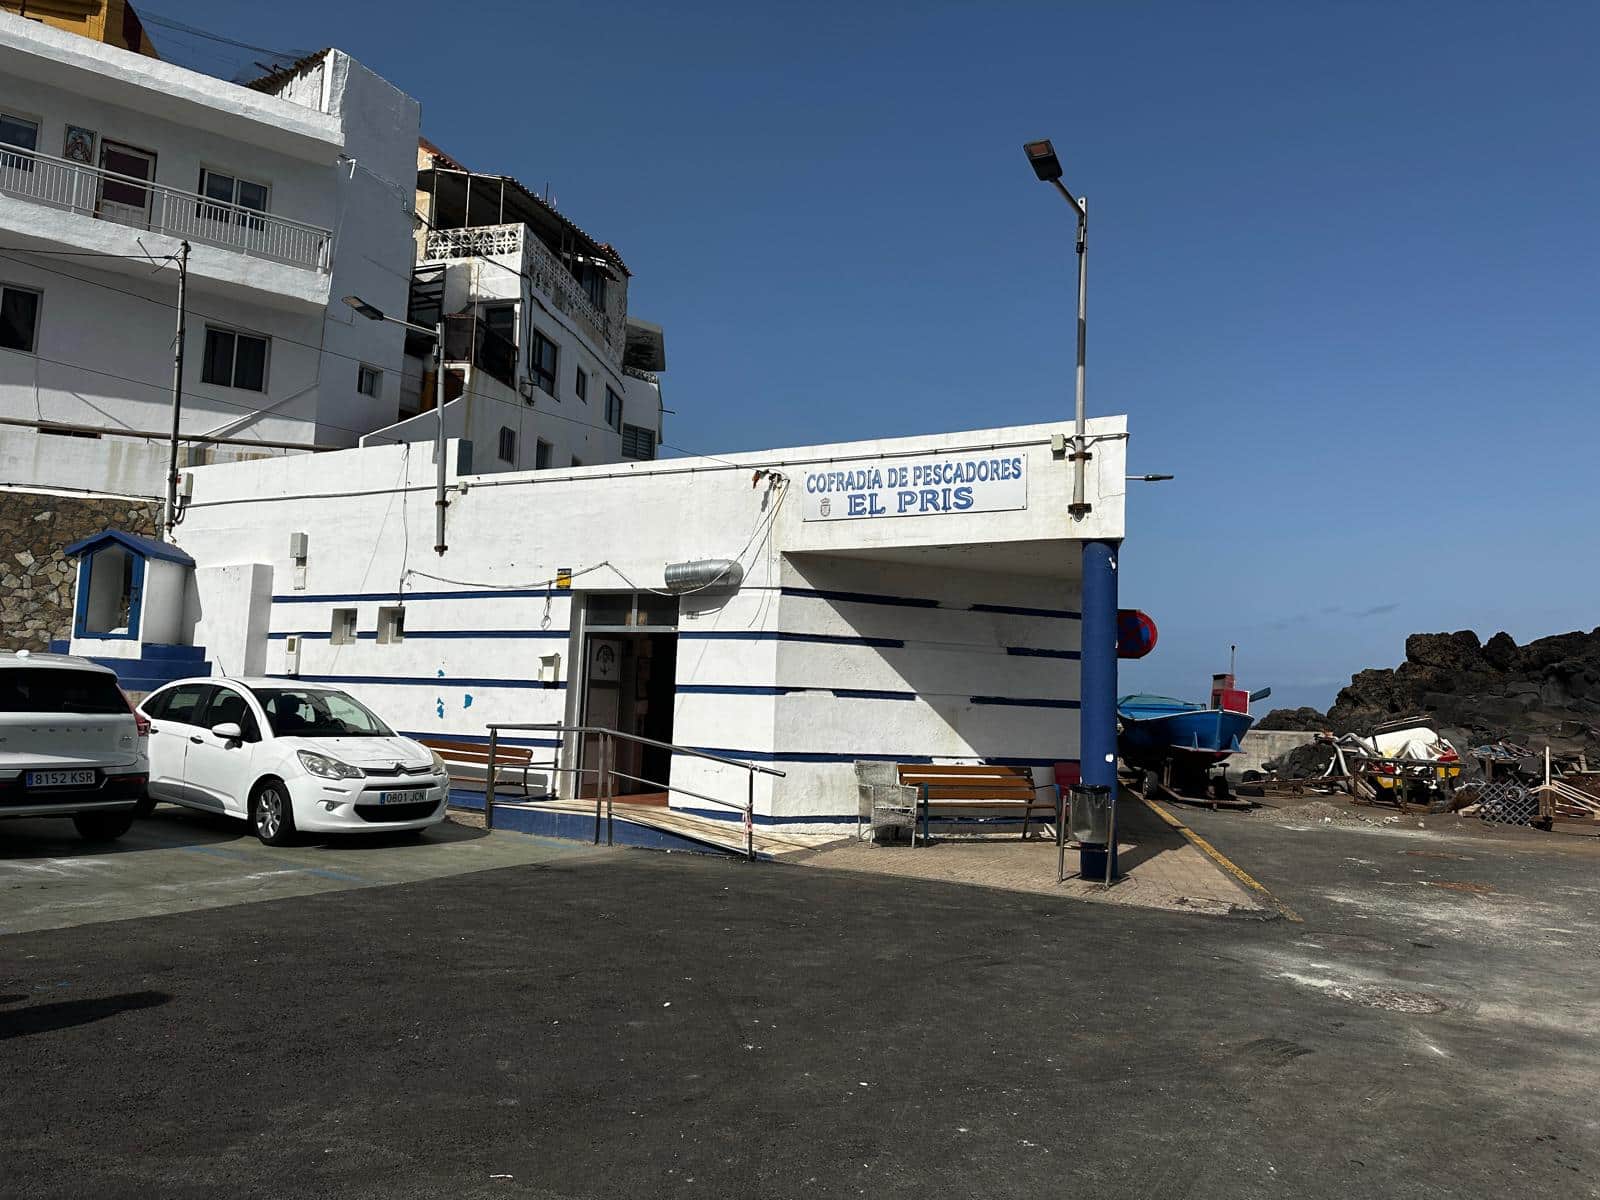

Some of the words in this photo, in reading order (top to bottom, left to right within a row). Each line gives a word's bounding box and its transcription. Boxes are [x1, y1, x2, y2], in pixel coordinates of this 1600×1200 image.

[887, 466, 908, 488] DE
[913, 458, 1022, 486] PESCADORES
[847, 492, 886, 516] EL
[897, 486, 974, 513] PRIS
[35, 773, 67, 784] 8152
[70, 771, 94, 783] KSR
